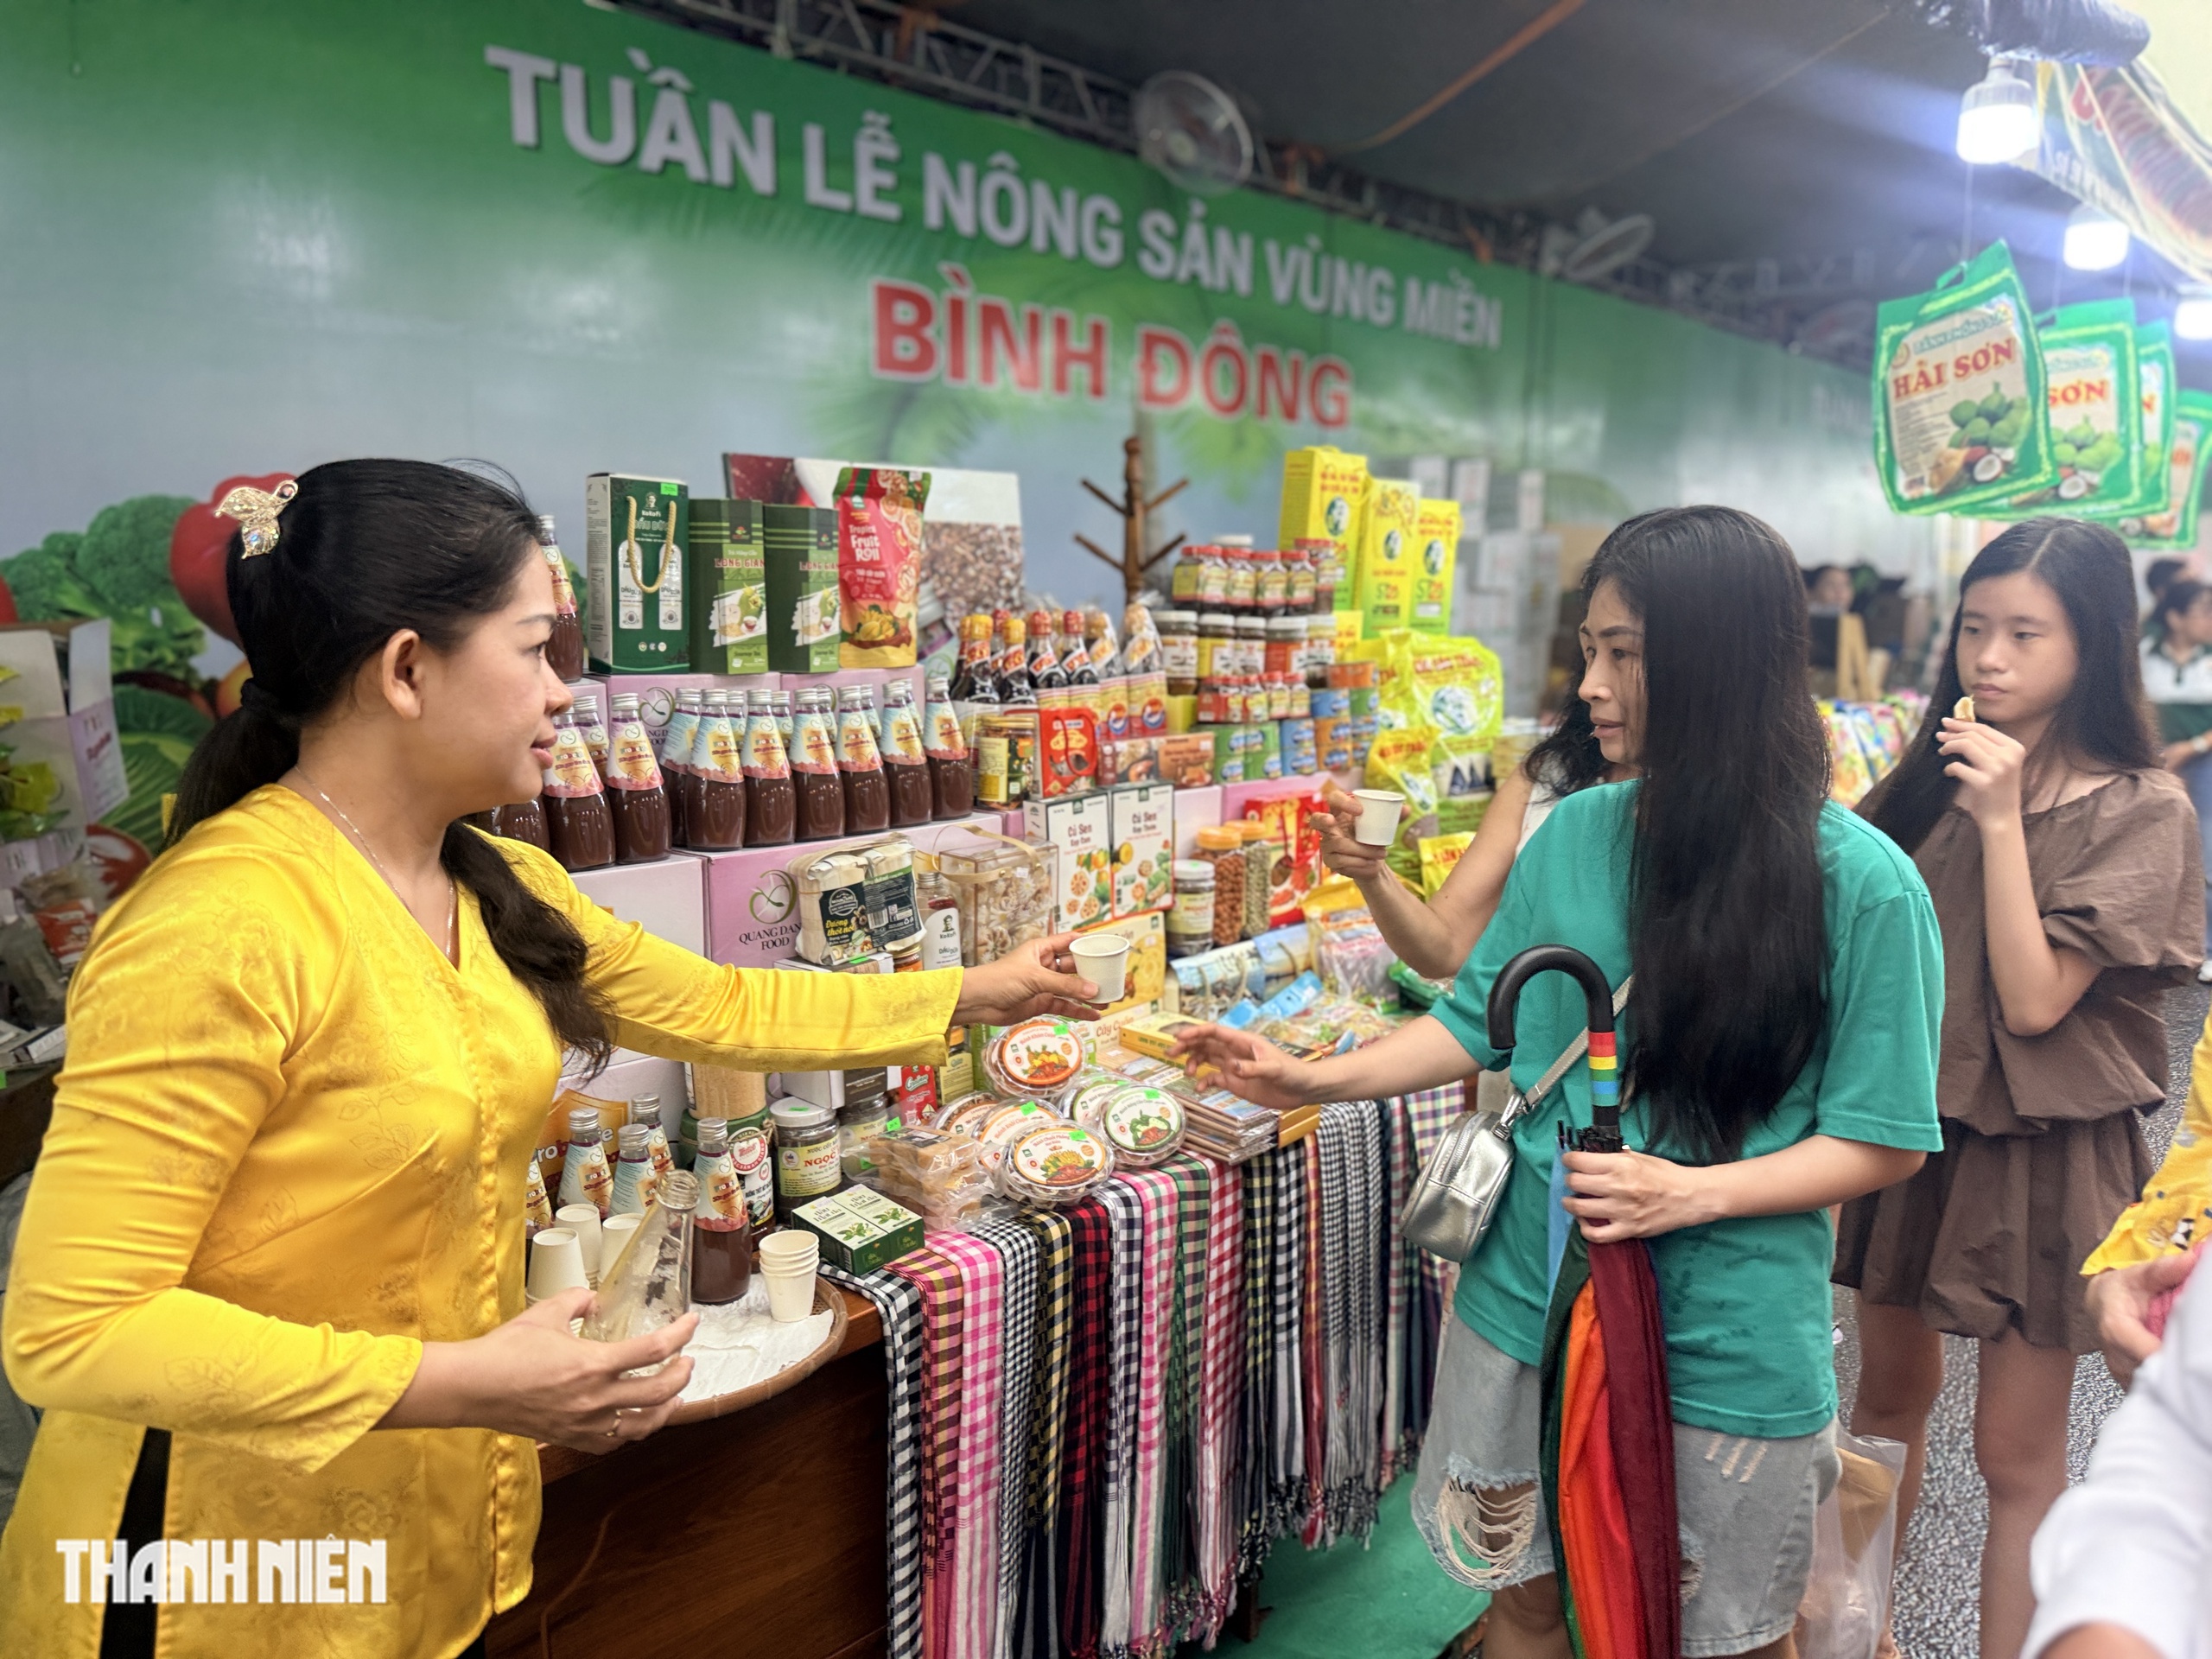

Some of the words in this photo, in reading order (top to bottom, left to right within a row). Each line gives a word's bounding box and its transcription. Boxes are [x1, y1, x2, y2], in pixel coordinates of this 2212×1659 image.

[485, 45, 776, 197] TUẦN
[802, 110, 902, 222] LỄ
[921, 151, 1123, 268] NÔNG
[1138, 198, 1254, 298] SẢN
[1264, 234, 1395, 327] VÙNG
[1404, 267, 1503, 347] MIỀN
[874, 263, 1108, 400] BÌNH
[1136, 323, 1353, 429] ĐÔNG
[1892, 359, 1948, 399] HẢI
[1954, 338, 2015, 379] SƠN
[850, 534, 880, 549] Fruit
[1142, 810, 1158, 823] Sen
[1078, 823, 1093, 836] Sen
[739, 926, 779, 947] QUANG
[761, 936, 790, 950] FOOD
[804, 1151, 836, 1167] NGỌC
